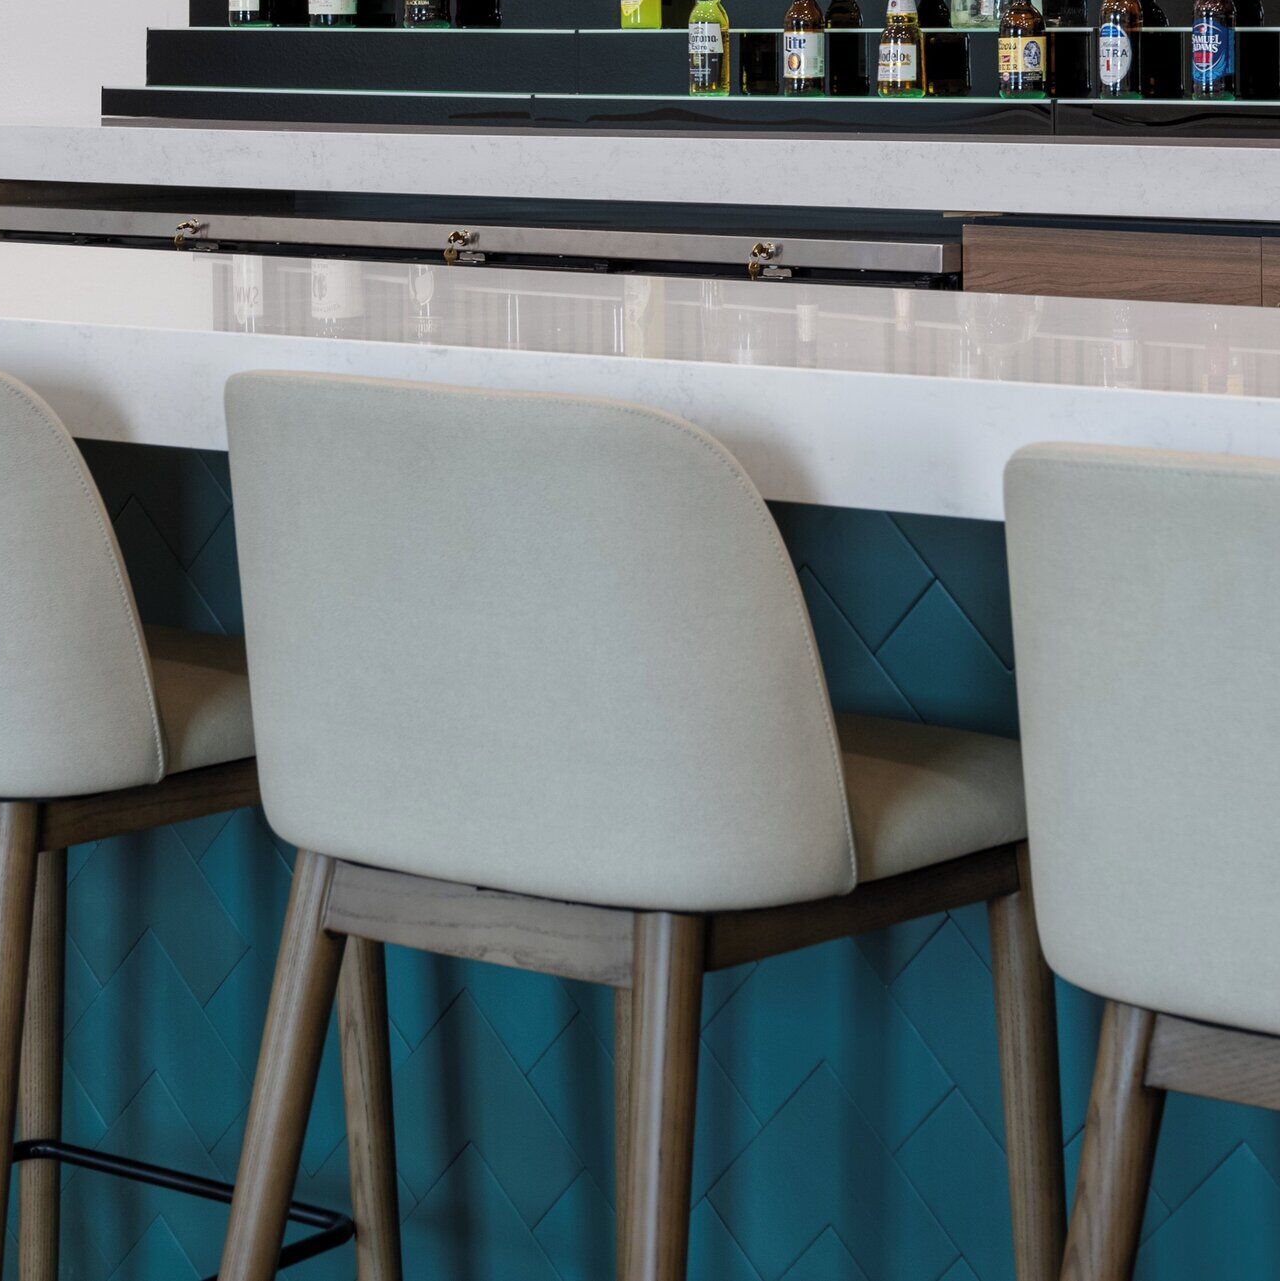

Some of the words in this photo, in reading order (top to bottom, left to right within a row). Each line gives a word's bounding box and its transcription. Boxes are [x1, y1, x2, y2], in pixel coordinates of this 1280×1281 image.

[785, 36, 806, 52] Lite
[1192, 33, 1222, 45] SAMUEL
[1100, 48, 1128, 58] LTRA
[1192, 42, 1218, 53] ADAMS
